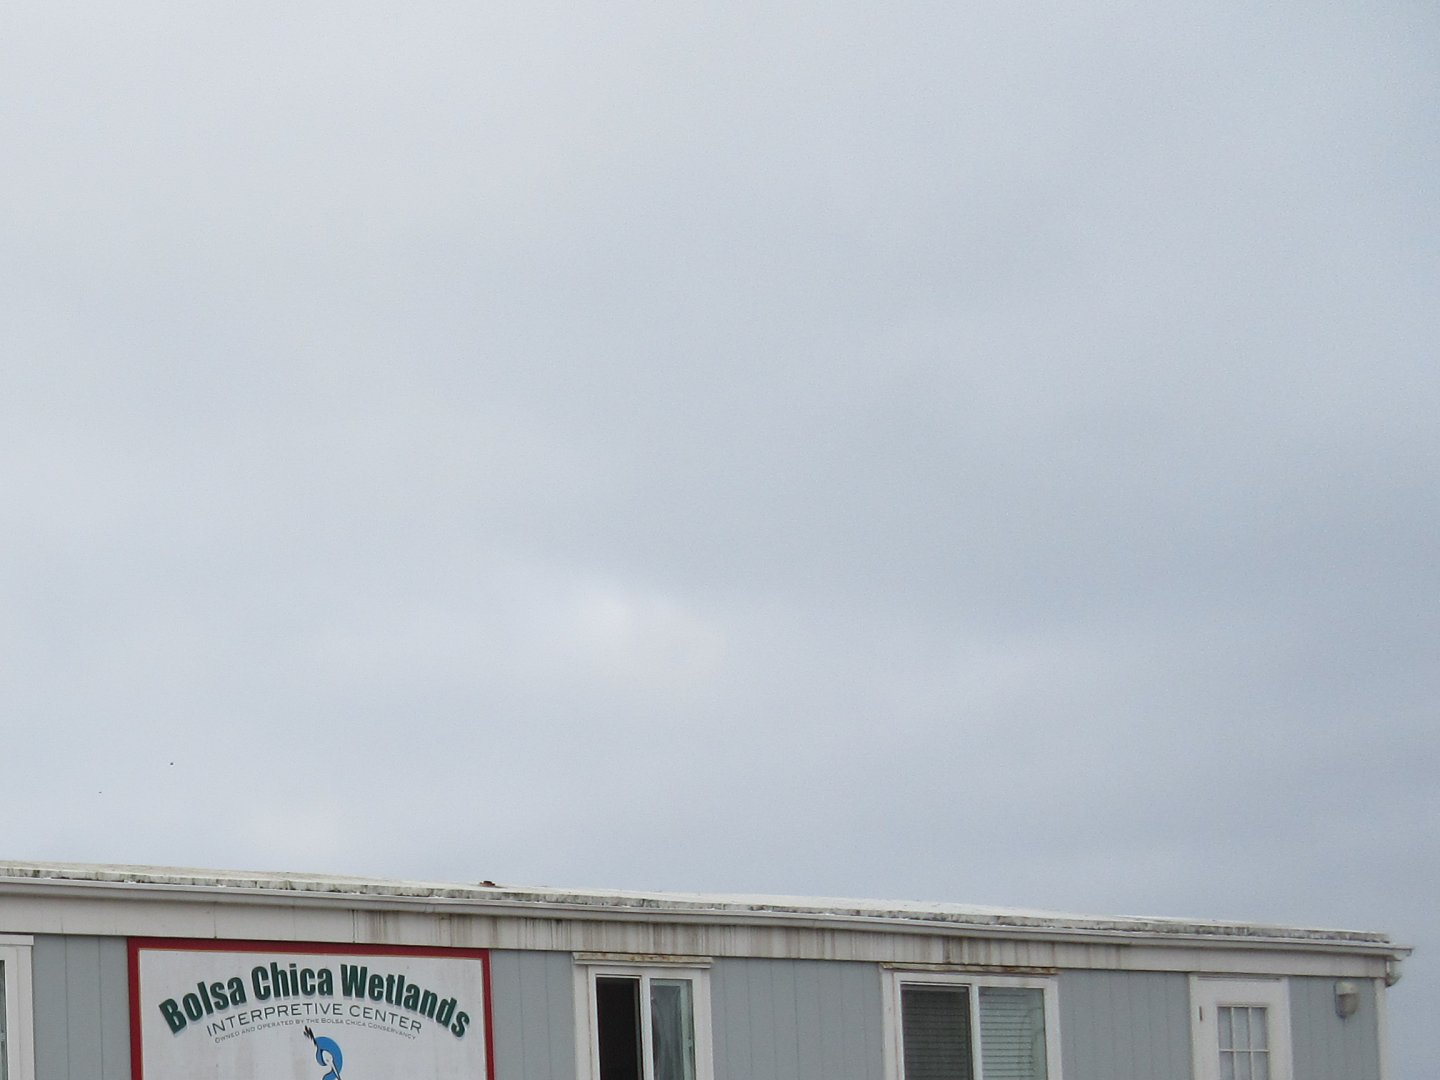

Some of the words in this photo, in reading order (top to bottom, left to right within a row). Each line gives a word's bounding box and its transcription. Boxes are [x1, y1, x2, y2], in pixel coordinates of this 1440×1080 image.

[158, 976, 247, 1034] Bolsa
[251, 962, 334, 1000] Chica
[340, 964, 470, 1038] Wetlands
[207, 1003, 343, 1036] INTERPRETIVE
[349, 1004, 422, 1034] CENTER
